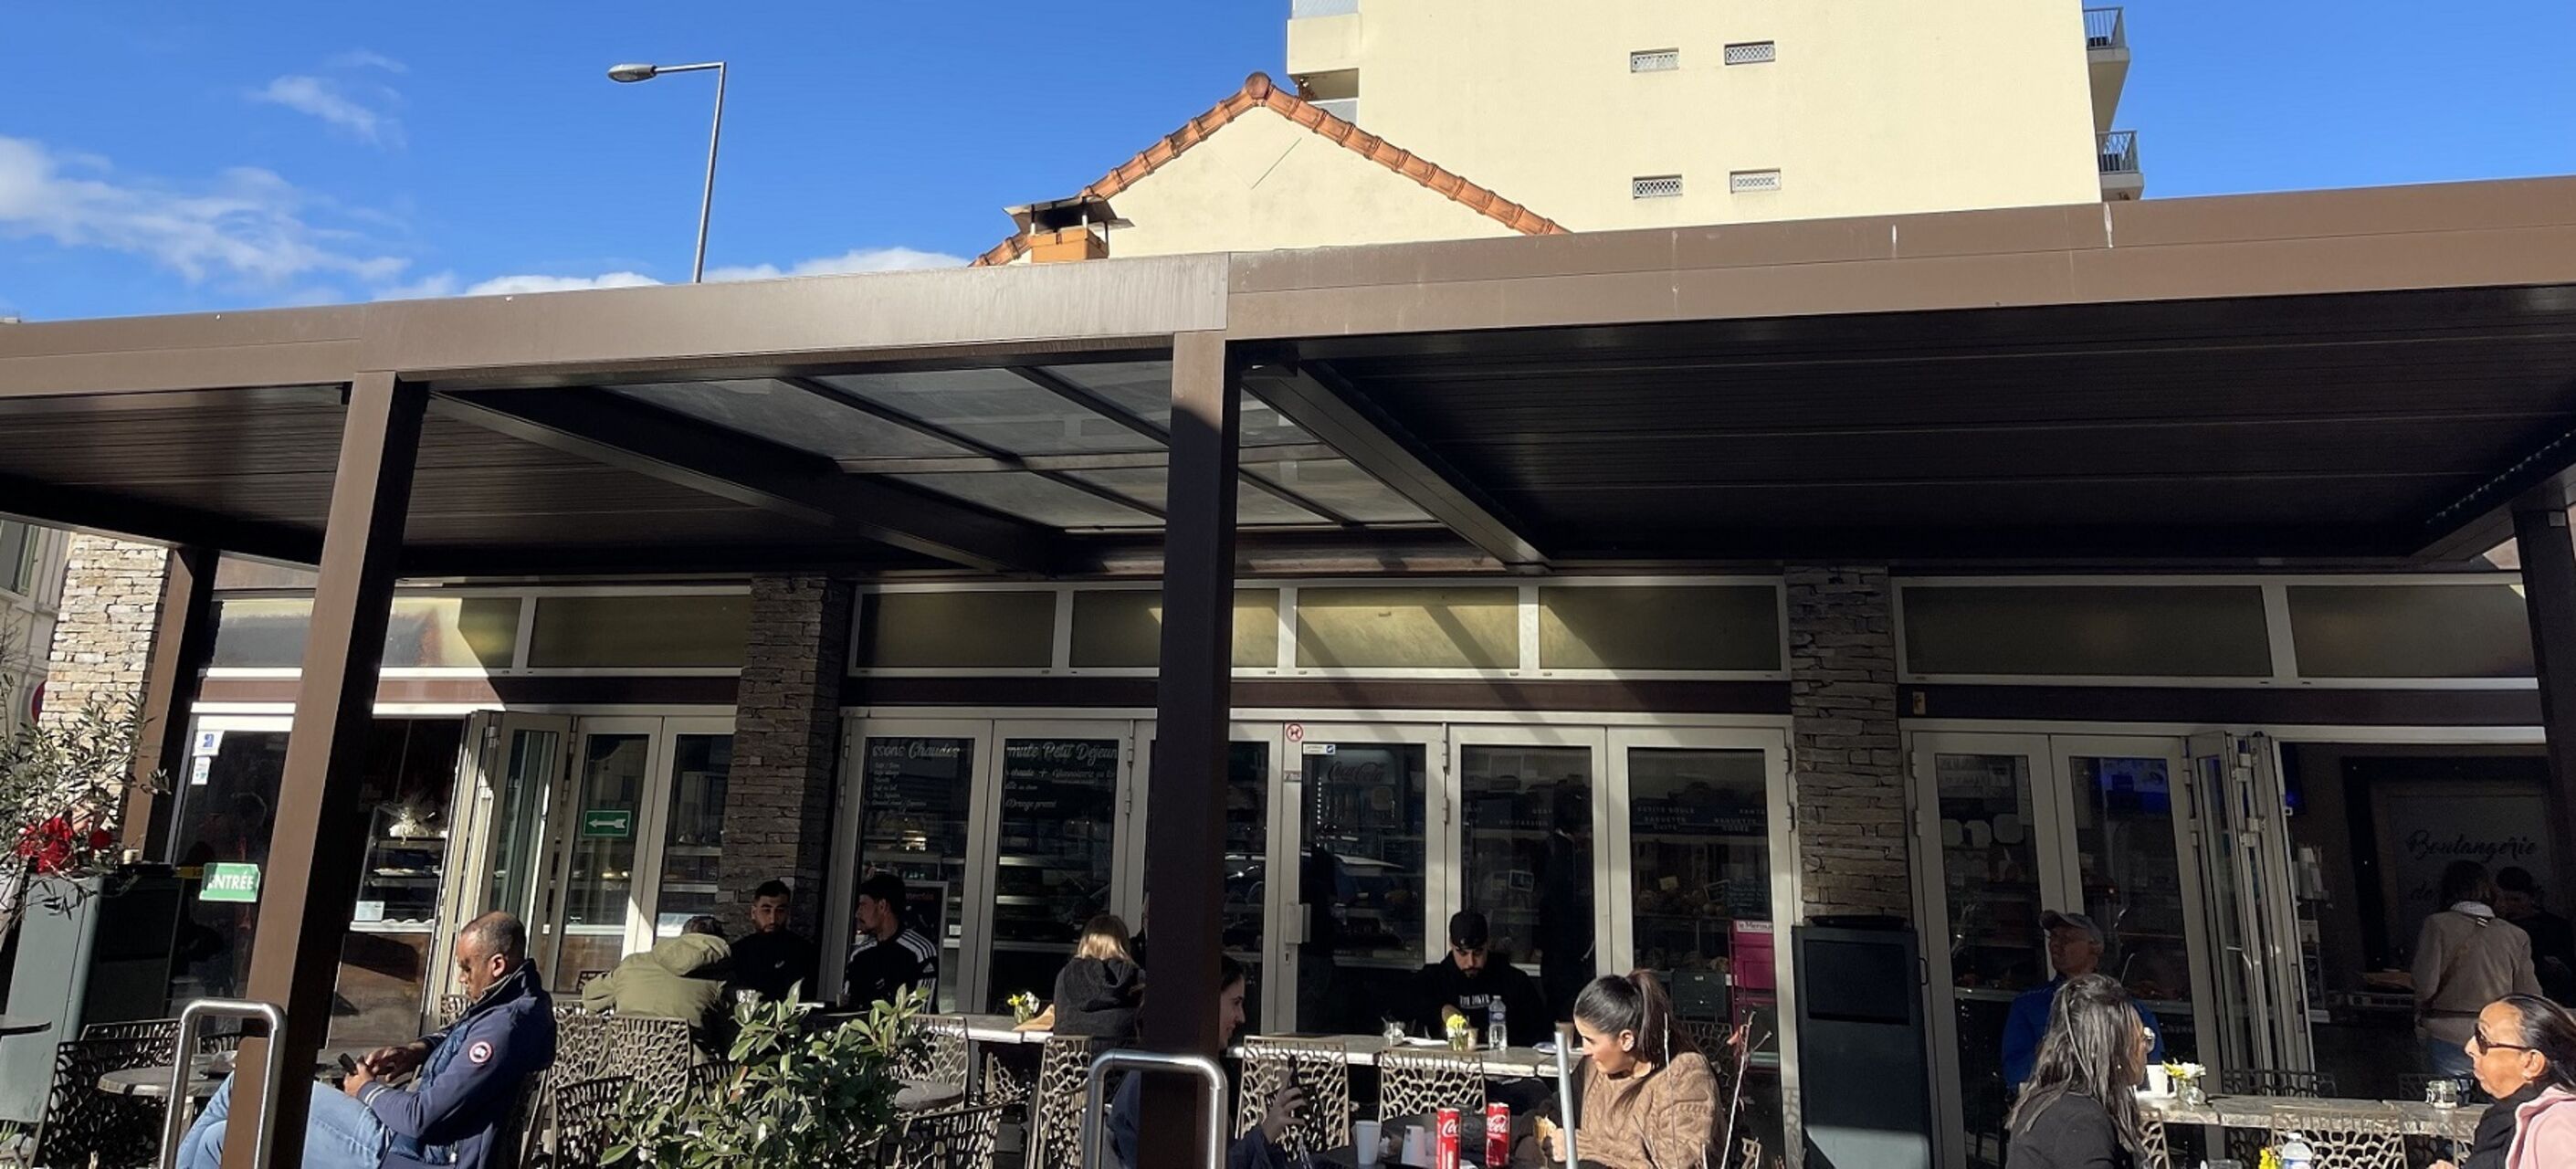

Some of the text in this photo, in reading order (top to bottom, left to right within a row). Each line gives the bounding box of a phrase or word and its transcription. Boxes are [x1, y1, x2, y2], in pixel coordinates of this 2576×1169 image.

[1043, 742, 1075, 758] Petit
[2406, 829, 2536, 863] Boulangerie
[207, 870, 254, 890] ENTRÉE
